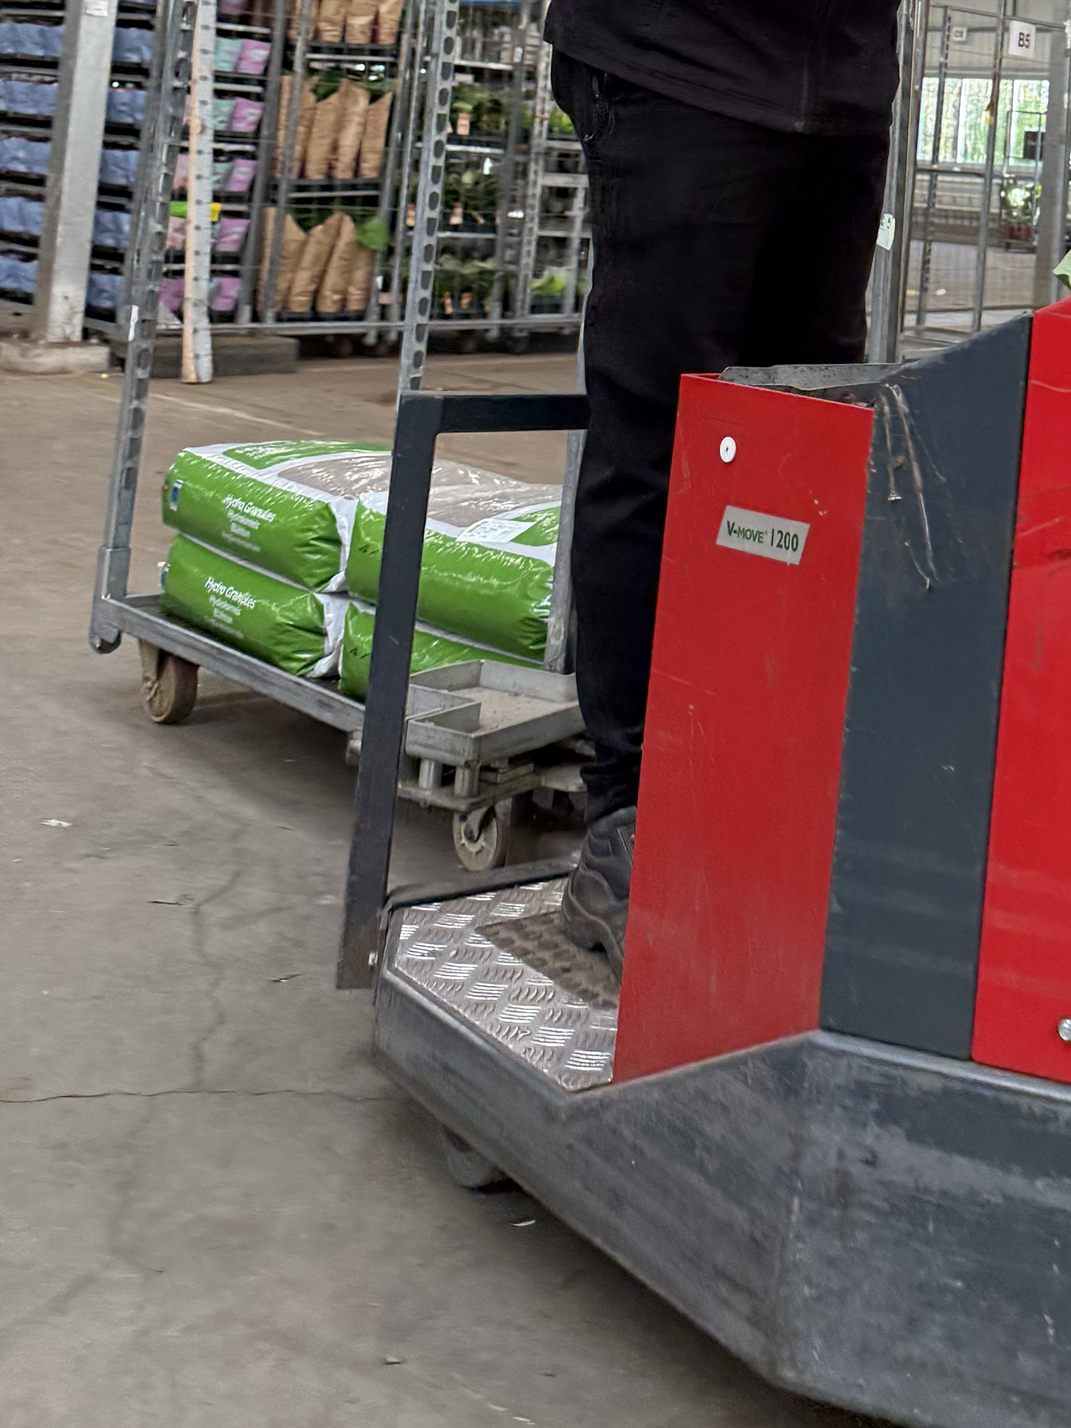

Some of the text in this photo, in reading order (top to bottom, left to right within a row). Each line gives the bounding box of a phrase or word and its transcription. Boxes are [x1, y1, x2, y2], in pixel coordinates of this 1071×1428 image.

[1017, 31, 1031, 48] B5
[770, 528, 799, 552] 1200
[204, 576, 227, 596] Hydro
[224, 586, 257, 610] Granules
